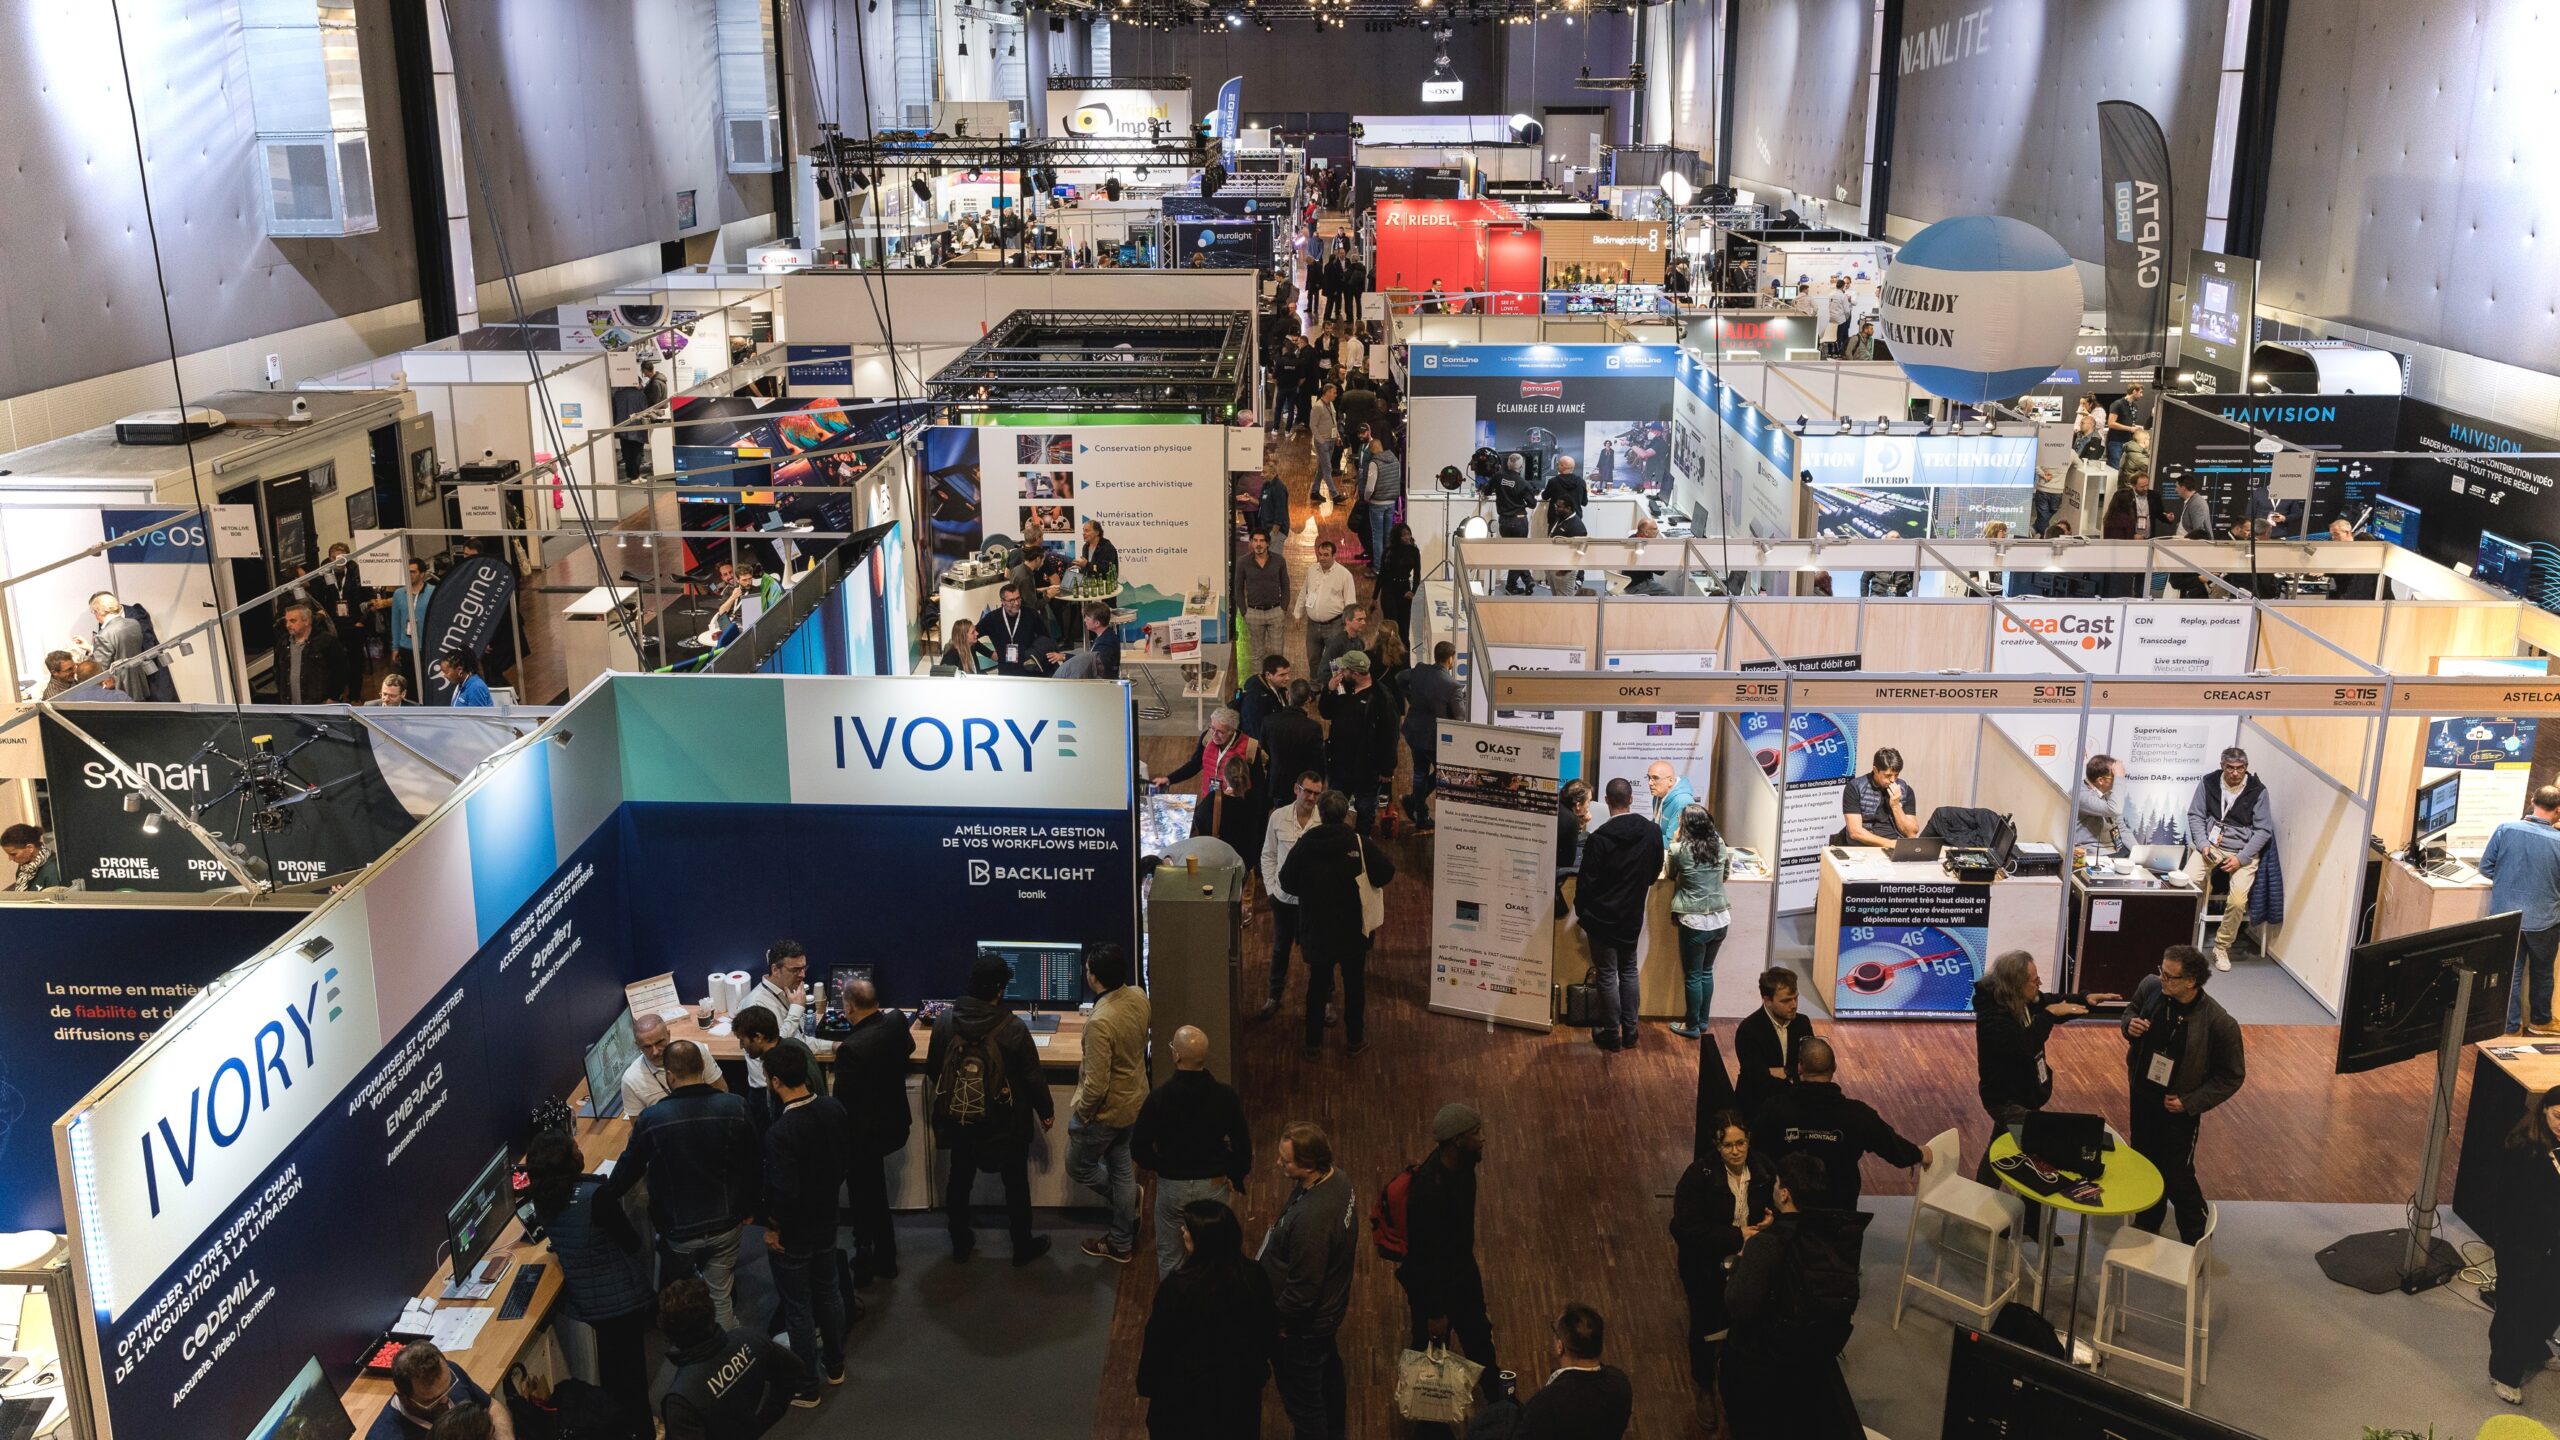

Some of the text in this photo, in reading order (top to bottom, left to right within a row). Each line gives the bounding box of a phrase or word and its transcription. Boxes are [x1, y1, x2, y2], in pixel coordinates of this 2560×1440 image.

[1899, 10, 1991, 76] NANLITE
[1409, 215, 1453, 226] RIEDEL
[1216, 233, 1252, 241] eurolight
[2076, 346, 2118, 356] CAPTA
[1442, 356, 1479, 364] ComLine
[2195, 371, 2217, 387] CAPTA
[1497, 402, 1586, 414] ÉCLAIRAGE LED AVANCÉ
[2223, 406, 2337, 422] HAIVISION
[2450, 423, 2522, 459] HAIVISION
[1153, 444, 1193, 453] physique
[1864, 476, 1911, 485] OLIVERDY
[2457, 460, 2539, 496] SUR TOUT TYPE RÉSEAU
[2532, 473, 2554, 488] VIDÉO
[1095, 480, 1193, 489] Expertise archivistique
[1096, 510, 1154, 518] Numérisation
[1969, 505, 2025, 513] PC-Stream1
[1155, 547, 1188, 555] digitale
[438, 566, 497, 653] imagine
[2002, 614, 2115, 634] CreaCast
[2180, 617, 2241, 626] Replay, podcast
[2000, 638, 2035, 646] creative
[2139, 637, 2187, 646] Transcodage
[1799, 659, 1856, 671] haut débit en
[2154, 657, 2210, 667] Live streaming
[1507, 686, 1661, 697] 8 OKAST
[1803, 688, 1999, 699] 7 INTERNET-BOOSTER
[2102, 690, 2271, 701] 6 CREACAST
[2403, 692, 2411, 701] 5
[1748, 715, 1838, 756] 3G 5G
[2134, 726, 2178, 735] Supervision
[833, 714, 1049, 772] IVORY
[1475, 740, 1521, 756] OKAST
[955, 823, 1105, 838] AMÉLIORER LA GESTION
[942, 838, 1119, 850] DE VOS WORKFLOWS MEDIA
[100, 857, 149, 869] DRONE
[187, 859, 229, 870] DRON
[277, 860, 327, 872] DRONE
[91, 866, 160, 880] STABILISÉ
[200, 871, 227, 882] FPV
[287, 871, 319, 882] LIVE
[995, 866, 1095, 881] BACKLIGHT
[1018, 889, 1047, 899] iconik
[1880, 884, 1956, 894] Internet-Booster
[510, 862, 583, 945] RENDRE VOTRE STOCKAGE
[1845, 896, 1887, 904] Connexion
[1888, 896, 1918, 904] internet
[1936, 896, 1954, 904] haut
[1955, 896, 1975, 904] débit
[1845, 905, 1856, 913] 5G
[1857, 906, 1889, 915] agrégée
[1890, 906, 1909, 915] pour
[1910, 906, 1930, 914] votre
[1931, 906, 1974, 914] événement
[500, 863, 595, 973] ACCESSIBLE, ÉVOLUTIF INTÉGRÉ
[1862, 915, 1910, 924] déploiement
[1922, 916, 1949, 924] réseau
[1851, 926, 1961, 977] 3G 4G 5G
[46, 982, 147, 996] La norme en
[51, 1005, 159, 1019] de fiabilité et
[54, 1027, 135, 1041] diffusions
[349, 987, 465, 1117] AUTOMATISER ET ORCHESTRER
[370, 1019, 451, 1111] VOTRE SUPPLY CHAIN
[141, 980, 319, 1219] IVORY
[118, 1162, 297, 1358] OPTIMISER VOTRE SUPPLY CHAIN
[114, 1176, 303, 1385] DE L'ACQUISITION À LA LIVRAISON
[181, 1269, 260, 1362] CODEMILL
[211, 1331, 236, 1359] Video
[240, 1286, 276, 1330] Cantemo
[707, 1347, 749, 1395] IVORY
